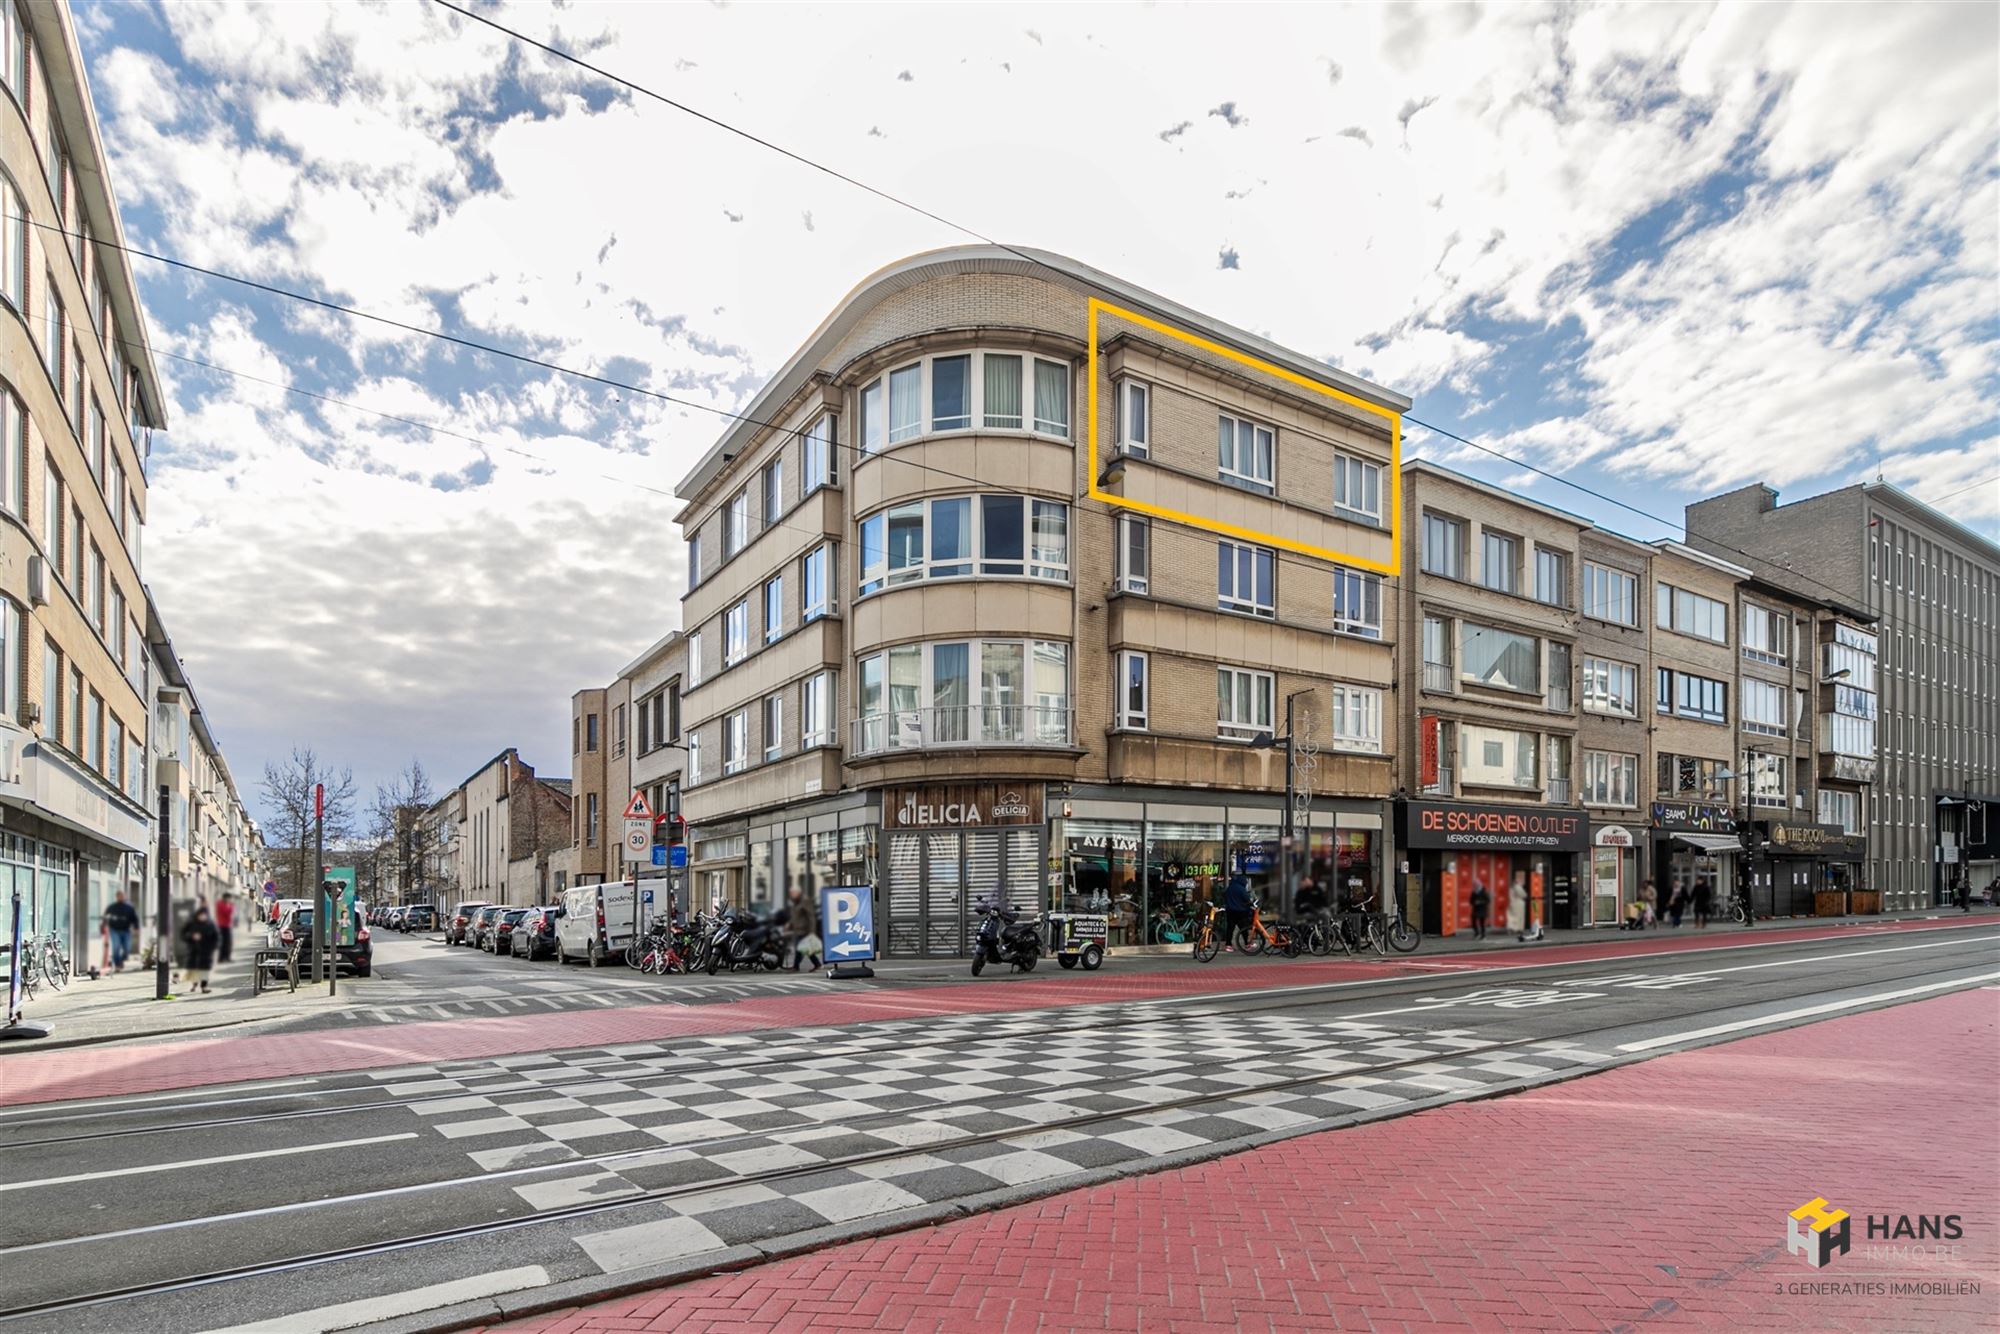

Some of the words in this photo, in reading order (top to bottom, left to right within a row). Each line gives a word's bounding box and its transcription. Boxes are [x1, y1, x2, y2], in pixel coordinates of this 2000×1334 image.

[1422, 811, 1444, 830] DE
[1447, 812, 1527, 833] SCHOENEN
[1529, 816, 1579, 834] OUTLET
[632, 836, 644, 845] 30
[1447, 834, 1500, 844] MERKSCHOENEN
[1500, 835, 1513, 844] AAN
[1513, 836, 1536, 845] OUTLET
[1785, 827, 1802, 841] THE
[643, 891, 651, 901] P
[827, 892, 859, 934] P
[845, 922, 871, 942] 24/7
